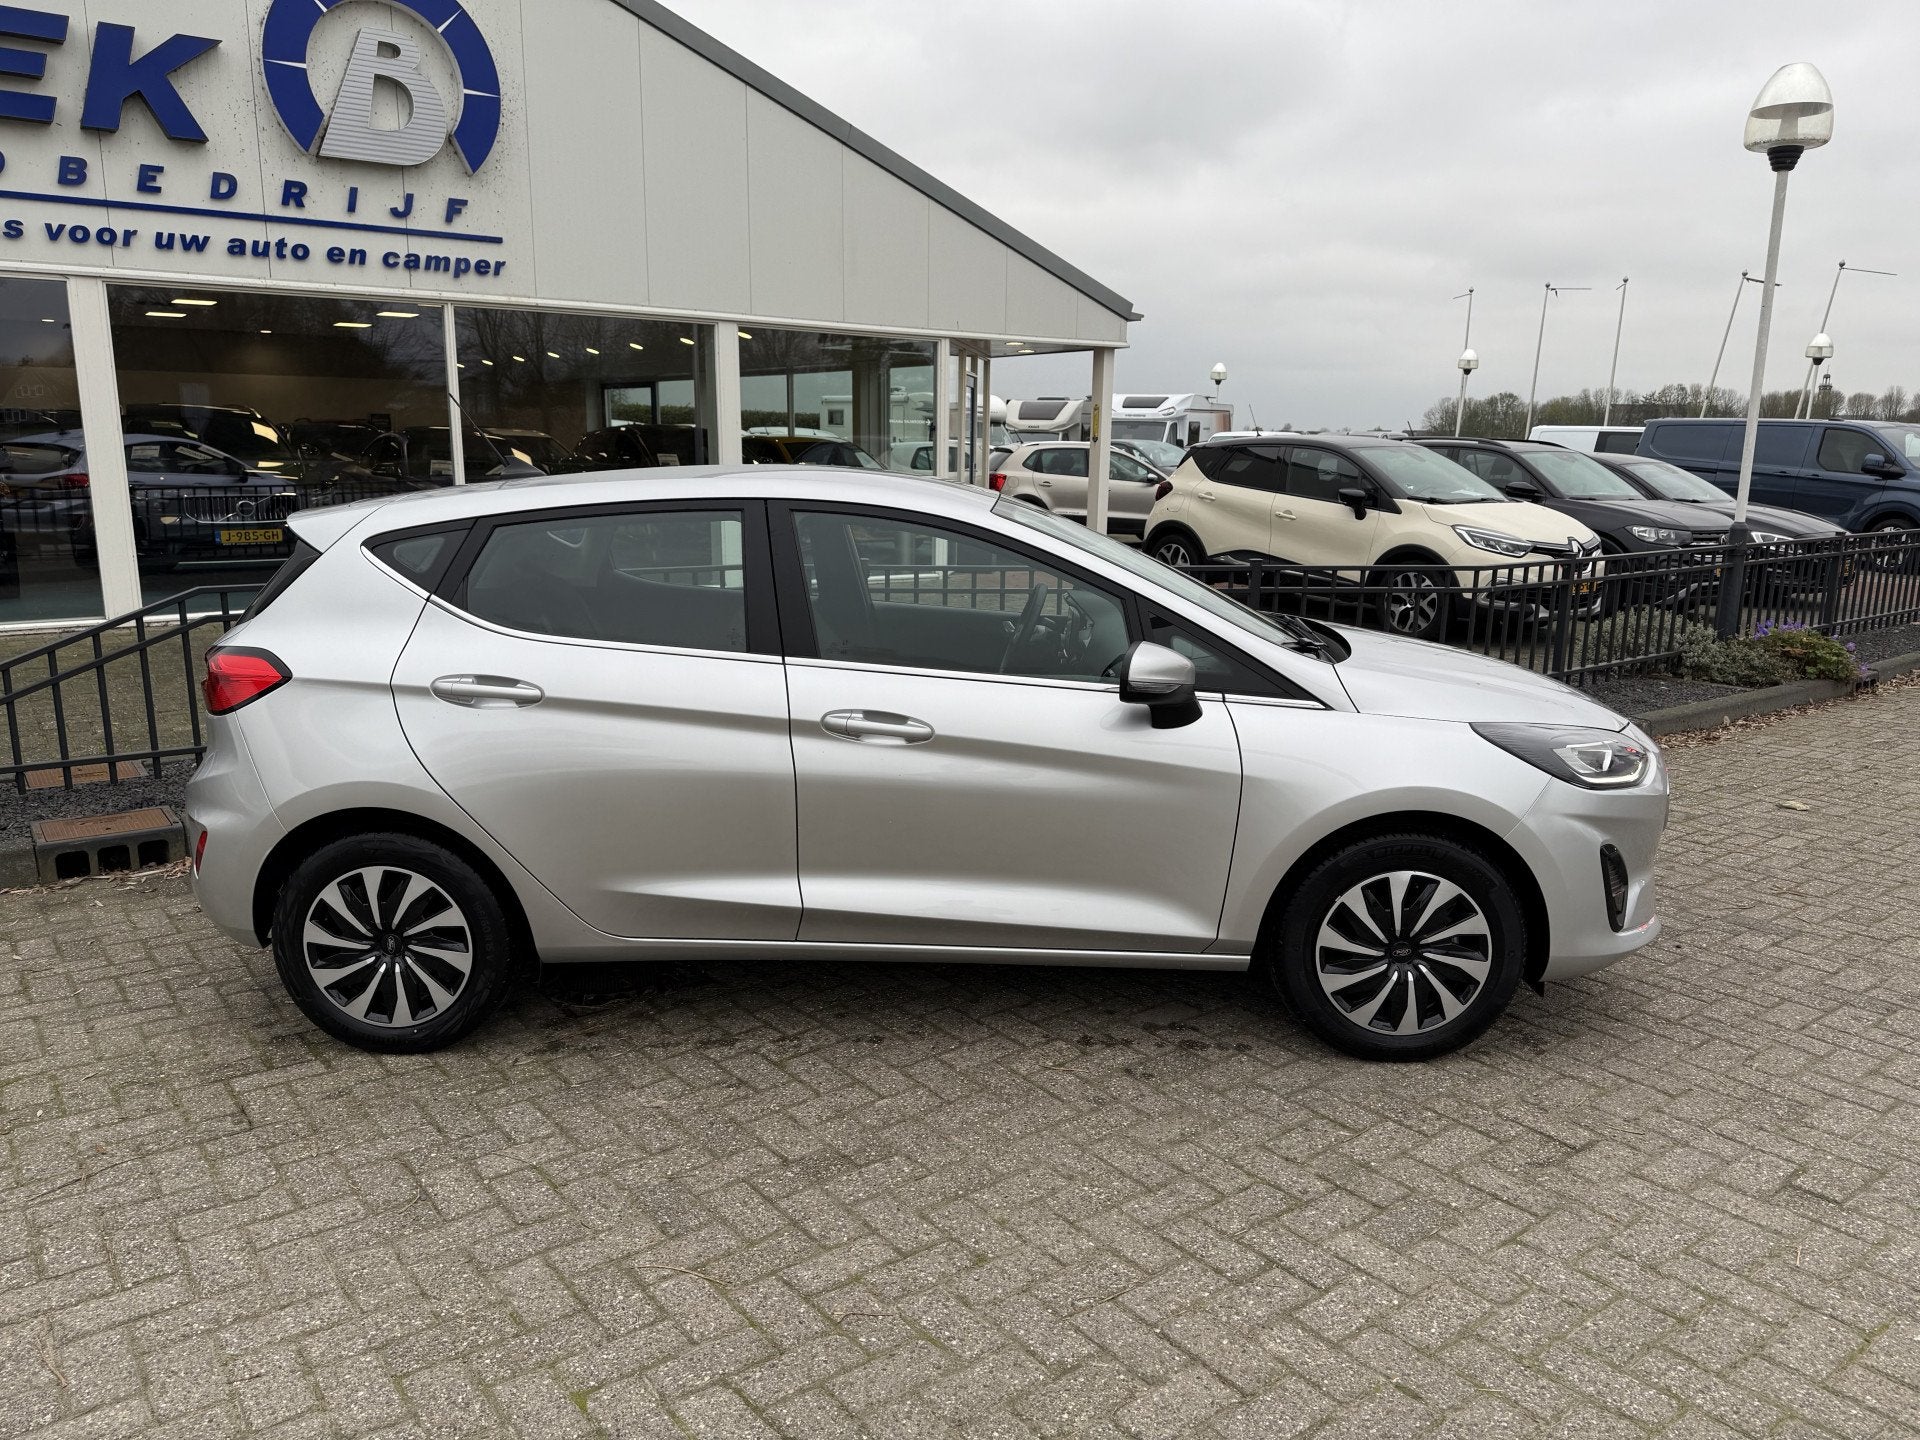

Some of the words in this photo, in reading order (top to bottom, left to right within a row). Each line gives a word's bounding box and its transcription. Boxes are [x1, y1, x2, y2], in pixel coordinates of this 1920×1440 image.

[318, 26, 448, 166] B
[0, 150, 469, 224] BEDRIJF
[44, 222, 137, 247] voor
[155, 232, 209, 253] uw
[227, 236, 310, 261] auto
[327, 246, 367, 265] en
[382, 248, 507, 278] camper
[225, 530, 279, 542] J-985-GH
